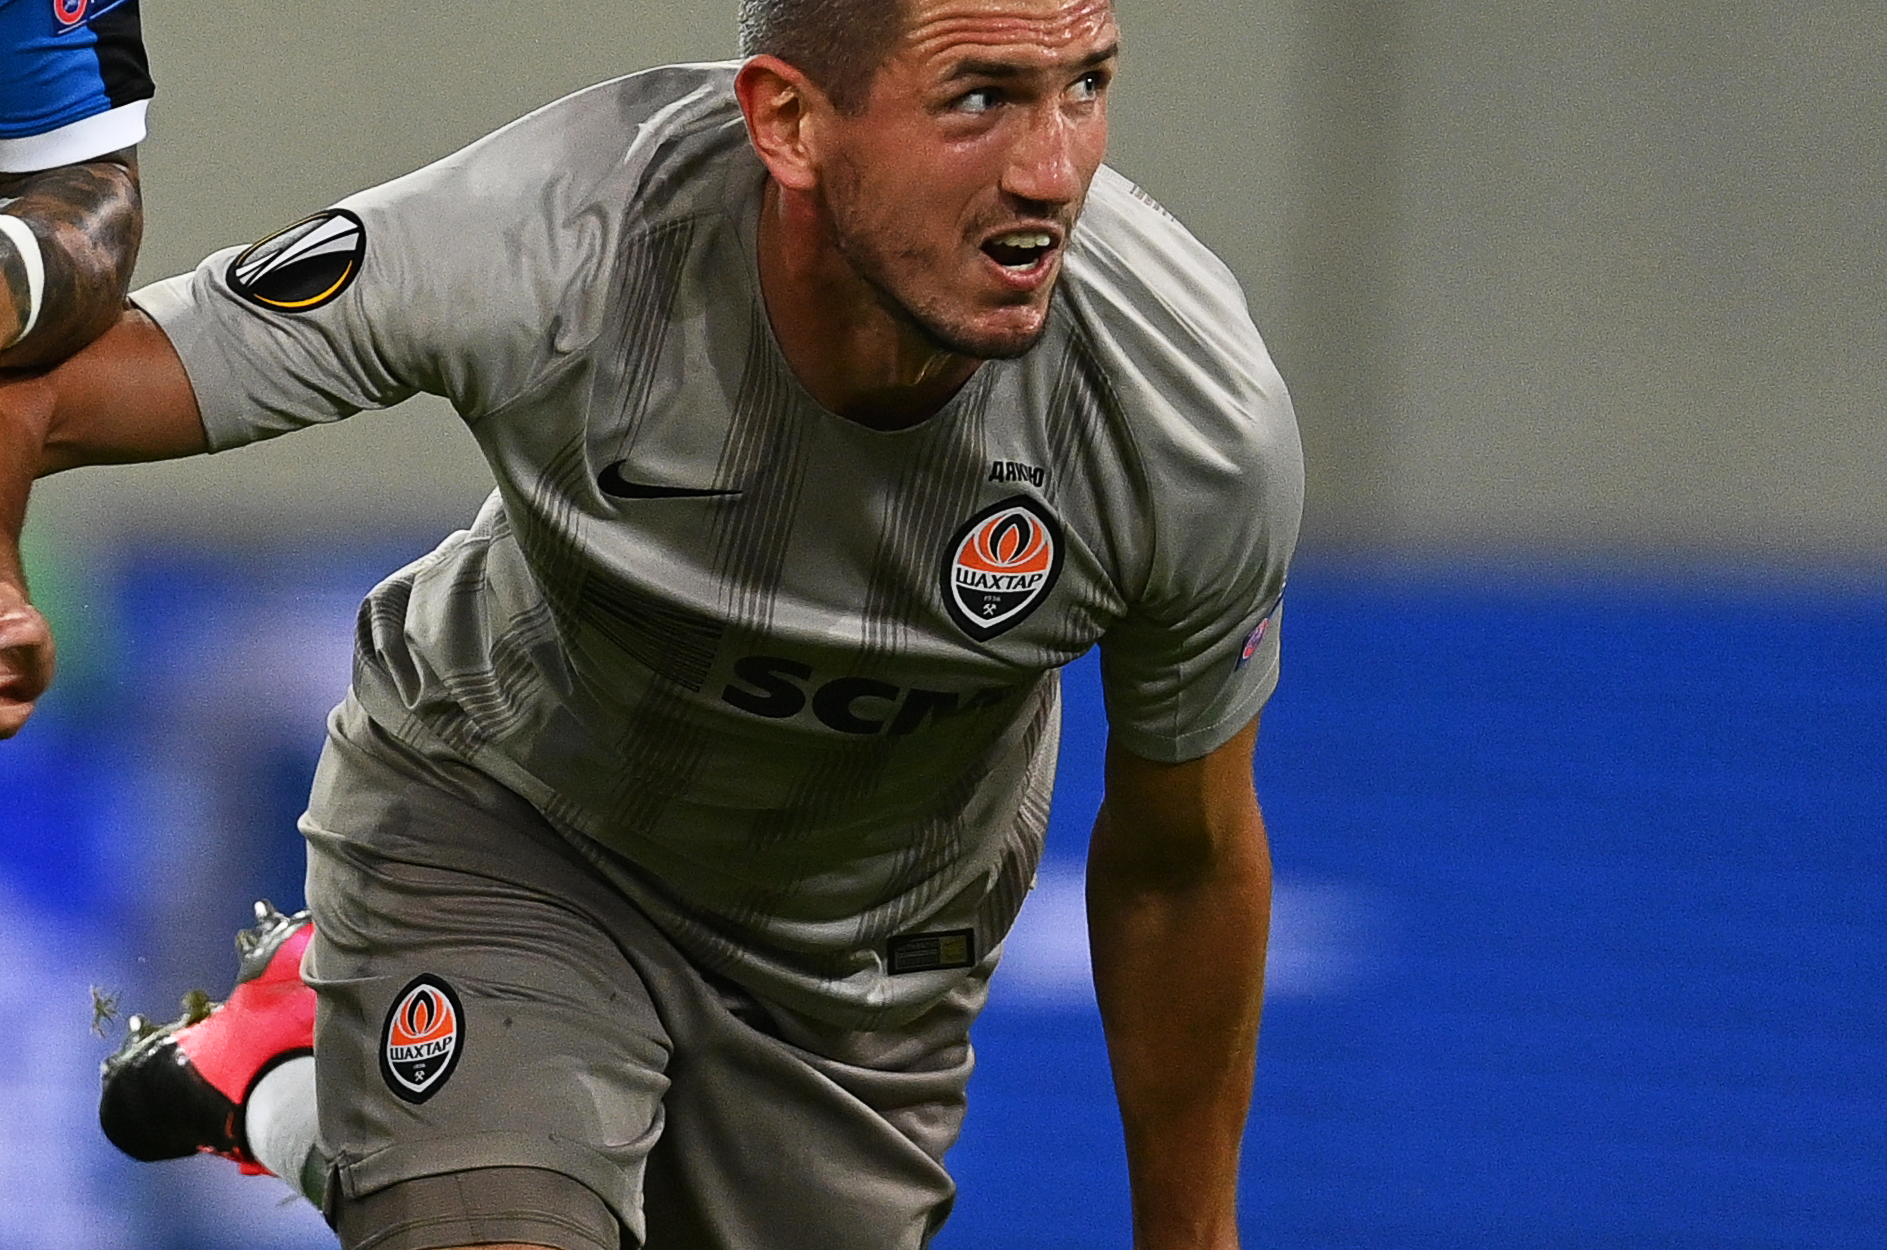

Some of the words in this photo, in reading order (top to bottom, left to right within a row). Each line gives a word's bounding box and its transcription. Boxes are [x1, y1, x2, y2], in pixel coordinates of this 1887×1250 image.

[988, 460, 1045, 488] ДЯКЮ
[955, 567, 1044, 591] ШАХТАР
[390, 1037, 453, 1060] ШАХТАР
